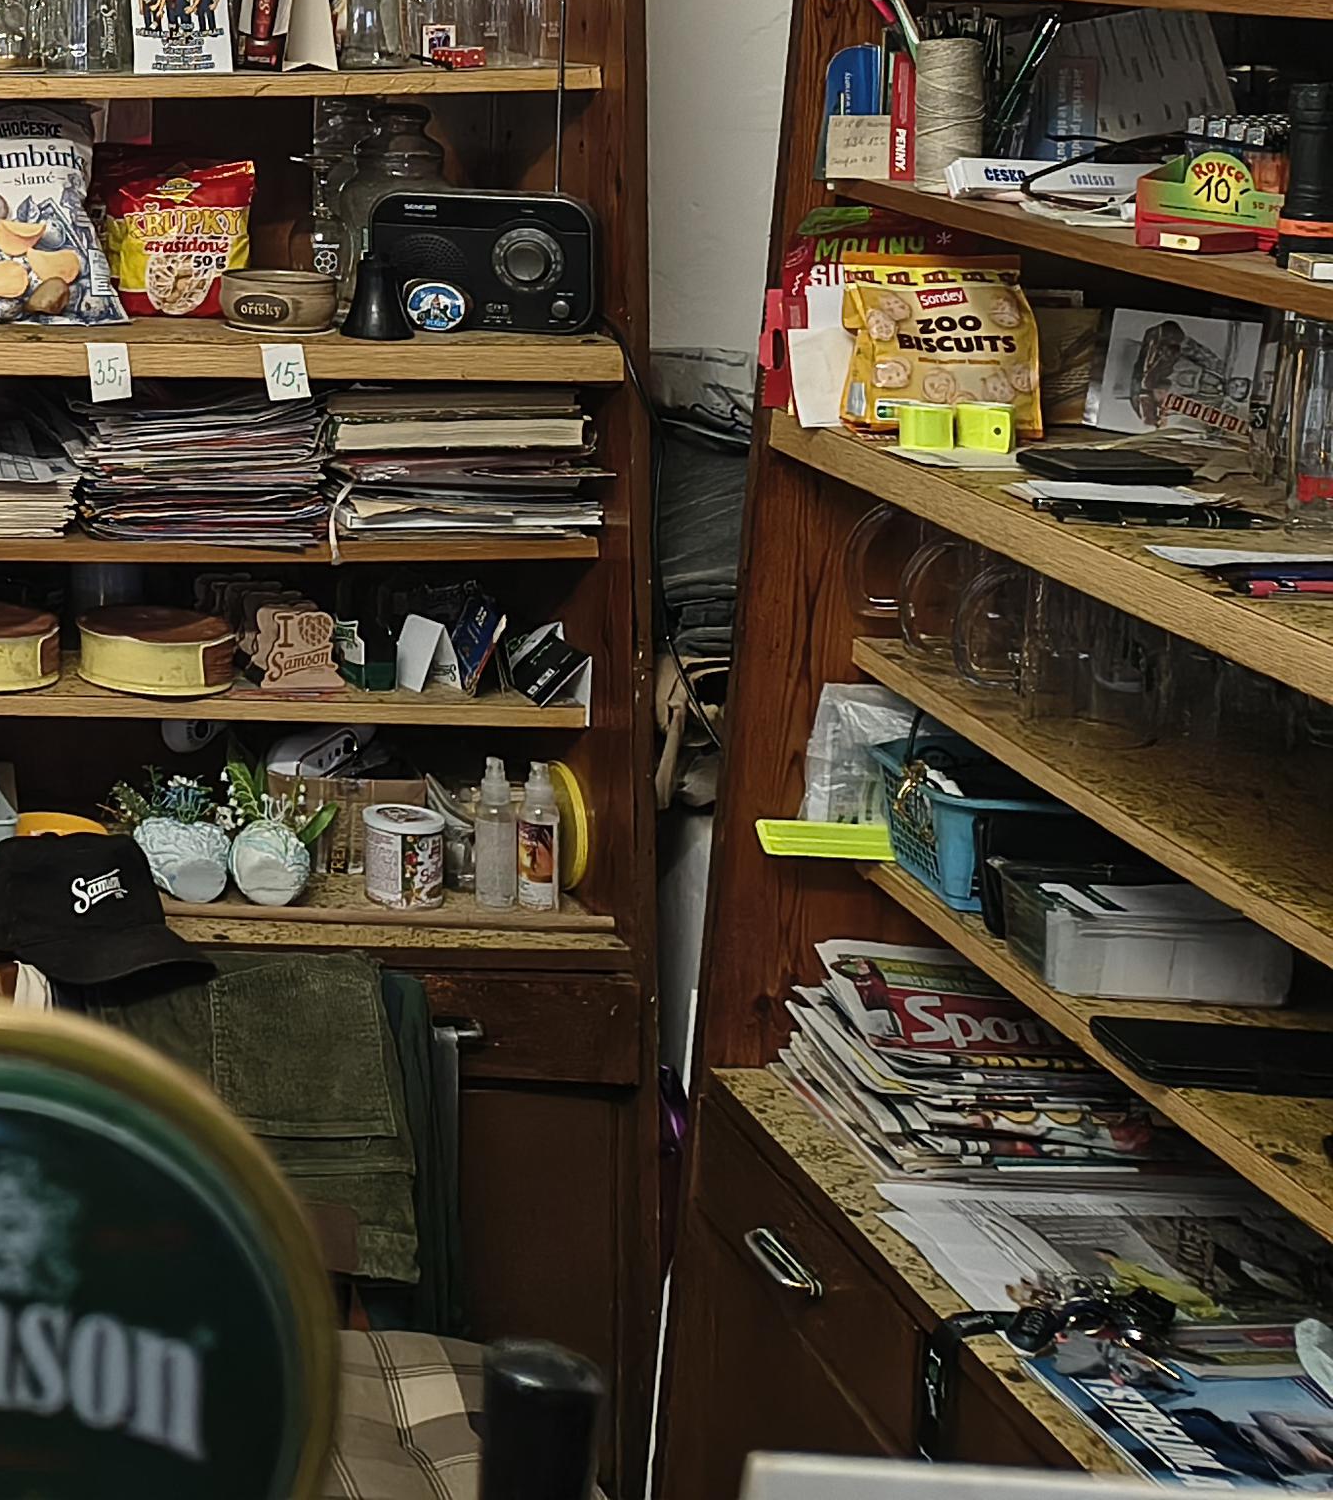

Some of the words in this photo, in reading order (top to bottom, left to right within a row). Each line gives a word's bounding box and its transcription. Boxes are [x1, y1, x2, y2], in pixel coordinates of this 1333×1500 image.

[1191, 160, 1245, 184] Royce
[1268, 202, 1284, 213] pc
[123, 203, 243, 239] KŘUPKY
[193, 255, 213, 269] 50
[920, 290, 964, 308] Sondey
[240, 303, 282, 319] oříšky
[916, 315, 982, 335] ZOO
[896, 334, 1017, 354] BISCUITS
[277, 615, 294, 647] I
[268, 645, 338, 683] Samson
[72, 869, 128, 914] Samson
